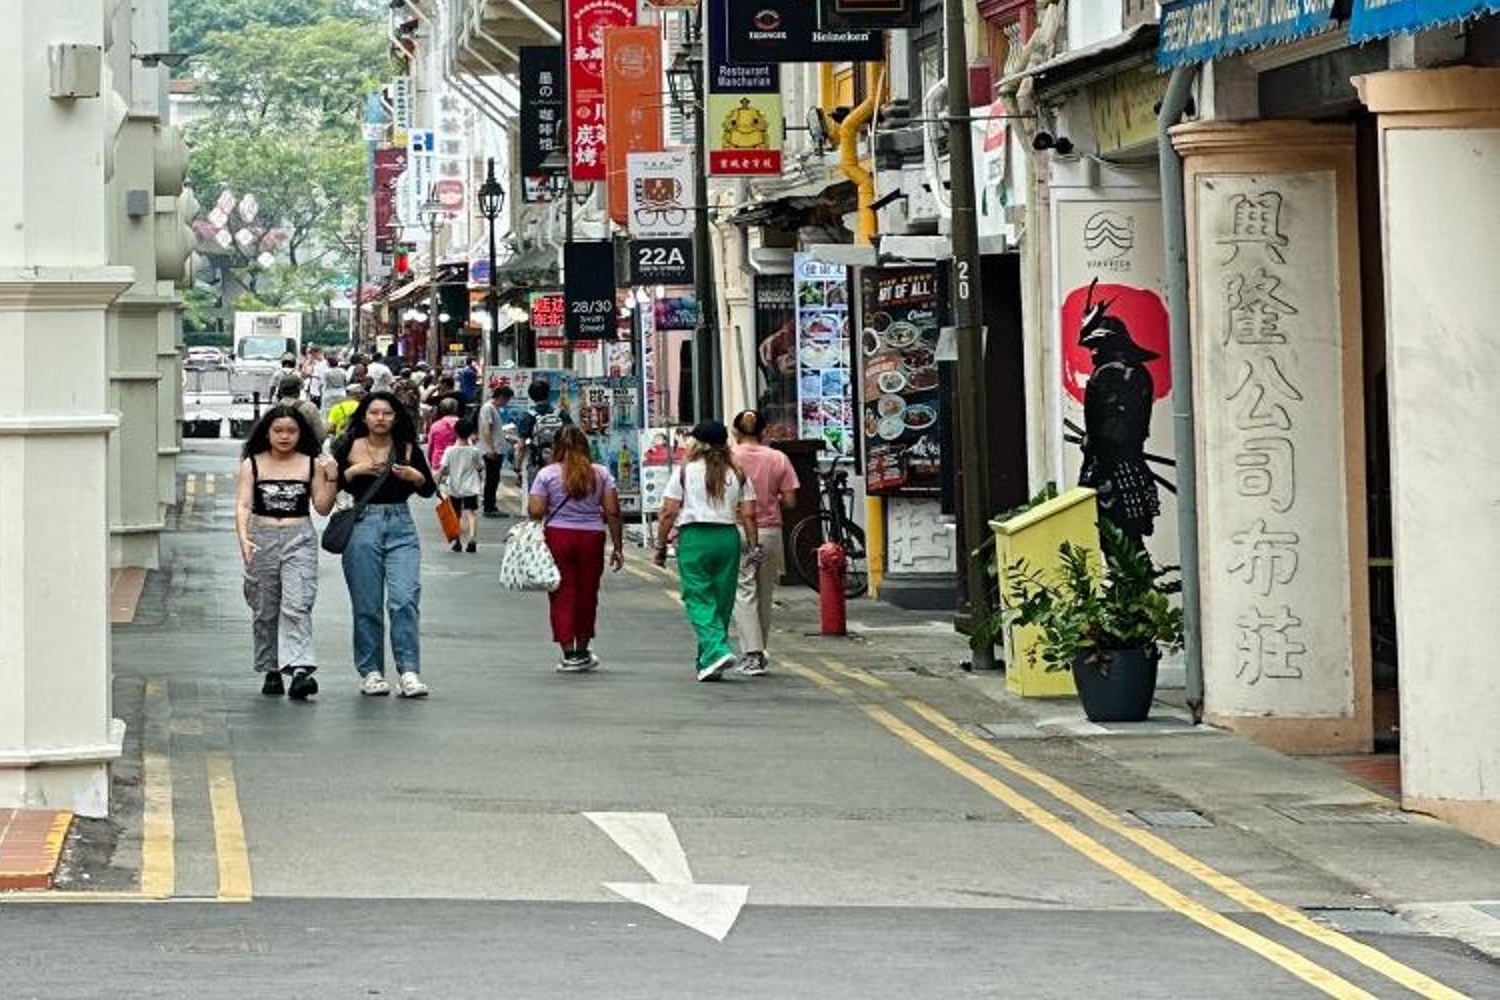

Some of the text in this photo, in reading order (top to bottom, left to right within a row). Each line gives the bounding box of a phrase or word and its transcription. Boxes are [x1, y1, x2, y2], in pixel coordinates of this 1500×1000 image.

[813, 31, 869, 42] Heineken
[719, 65, 769, 76] Restaurant
[639, 248, 685, 265] 22A
[572, 300, 612, 313] 28/30
[580, 315, 604, 323] Smith
[580, 324, 605, 333] Street
